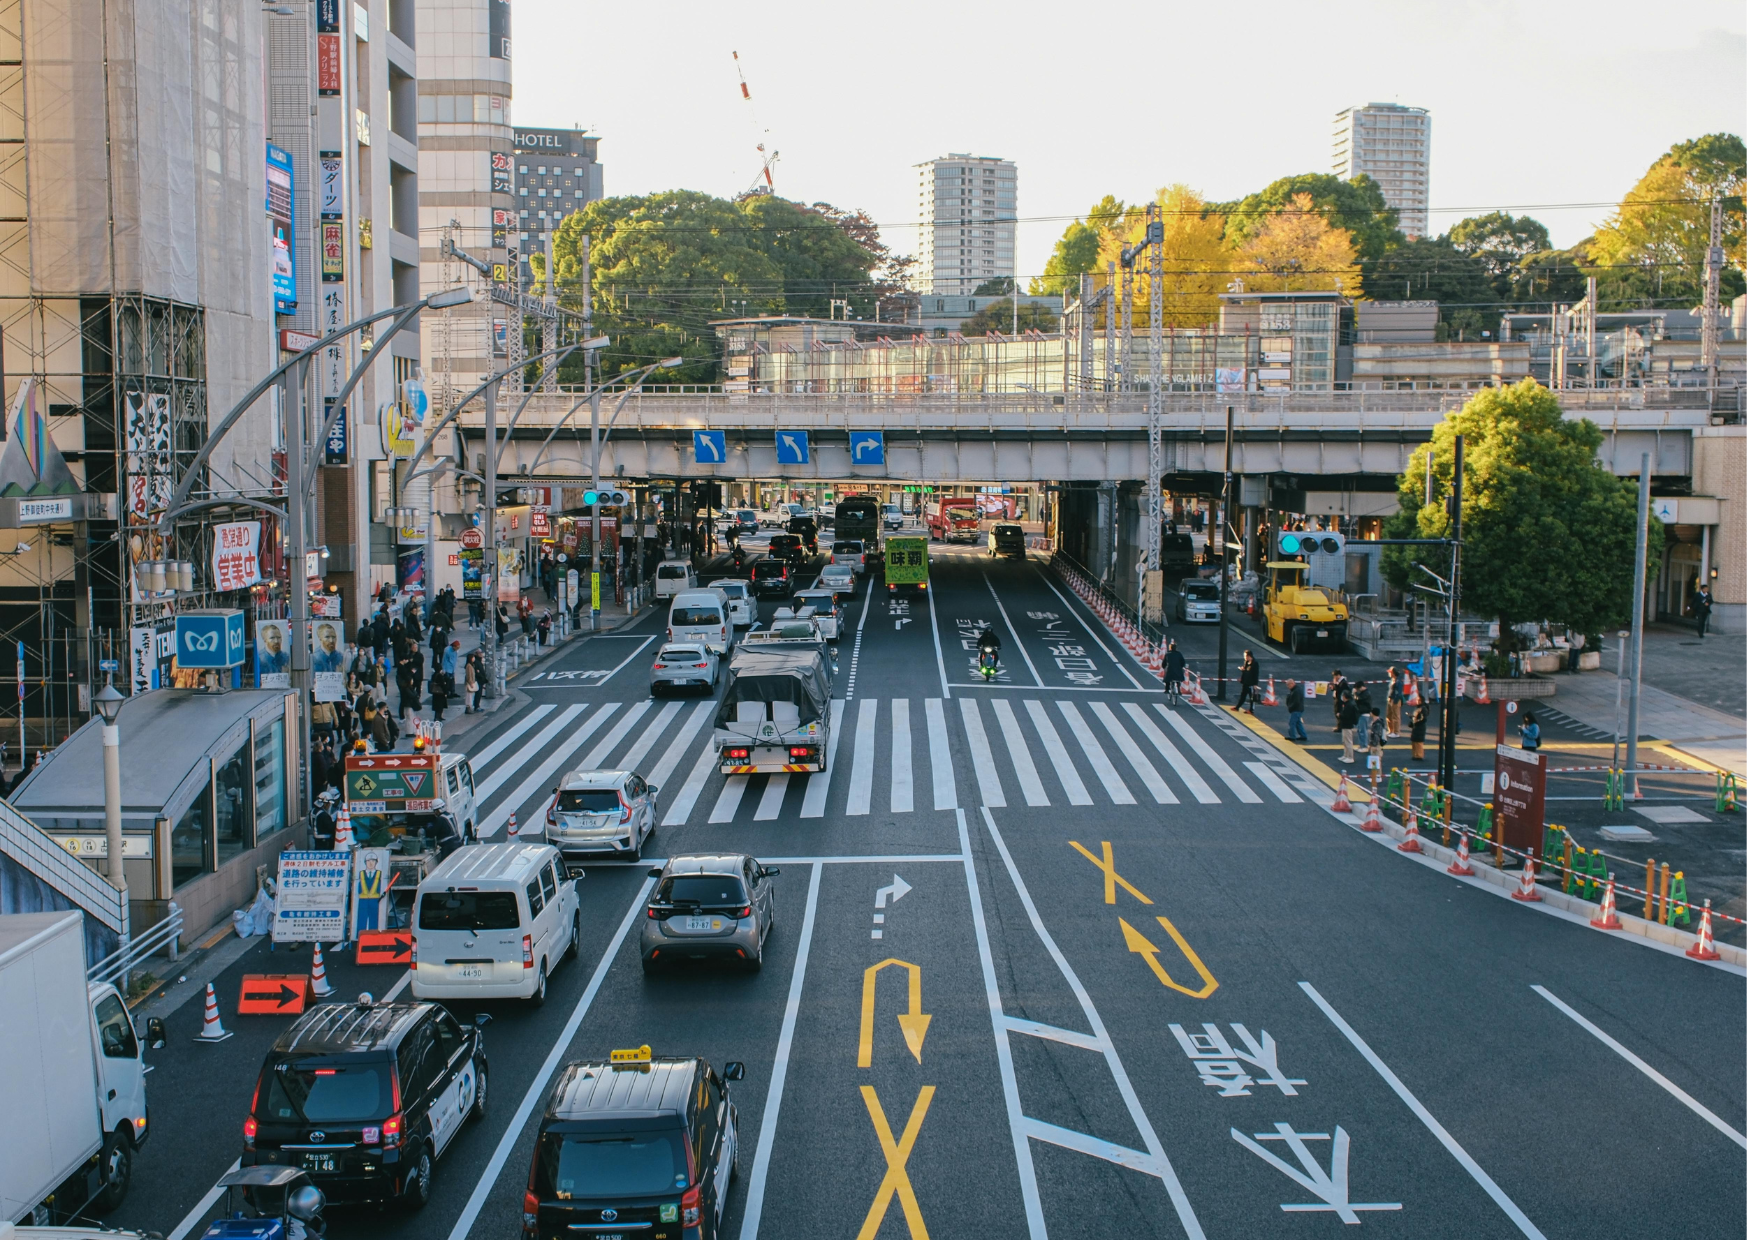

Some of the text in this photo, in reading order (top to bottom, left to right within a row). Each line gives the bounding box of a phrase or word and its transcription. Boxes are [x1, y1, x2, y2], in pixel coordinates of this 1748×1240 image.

[321, 55, 329, 88] クリニック
[514, 133, 563, 148] HOTEL
[324, 171, 338, 207] ダーツ
[324, 225, 341, 258] 麻雀
[20, 503, 64, 516] 上野御徒町中央通り
[217, 550, 256, 591] 営業中
[384, 789, 404, 797] 工事中
[1509, 780, 1534, 794] Information
[283, 852, 347, 860] ご迷惑をおかけします
[282, 869, 345, 879] 道路の維持補修
[283, 880, 343, 888] を行っています
[691, 921, 709, 929] 87-87
[462, 970, 482, 978] 44-90
